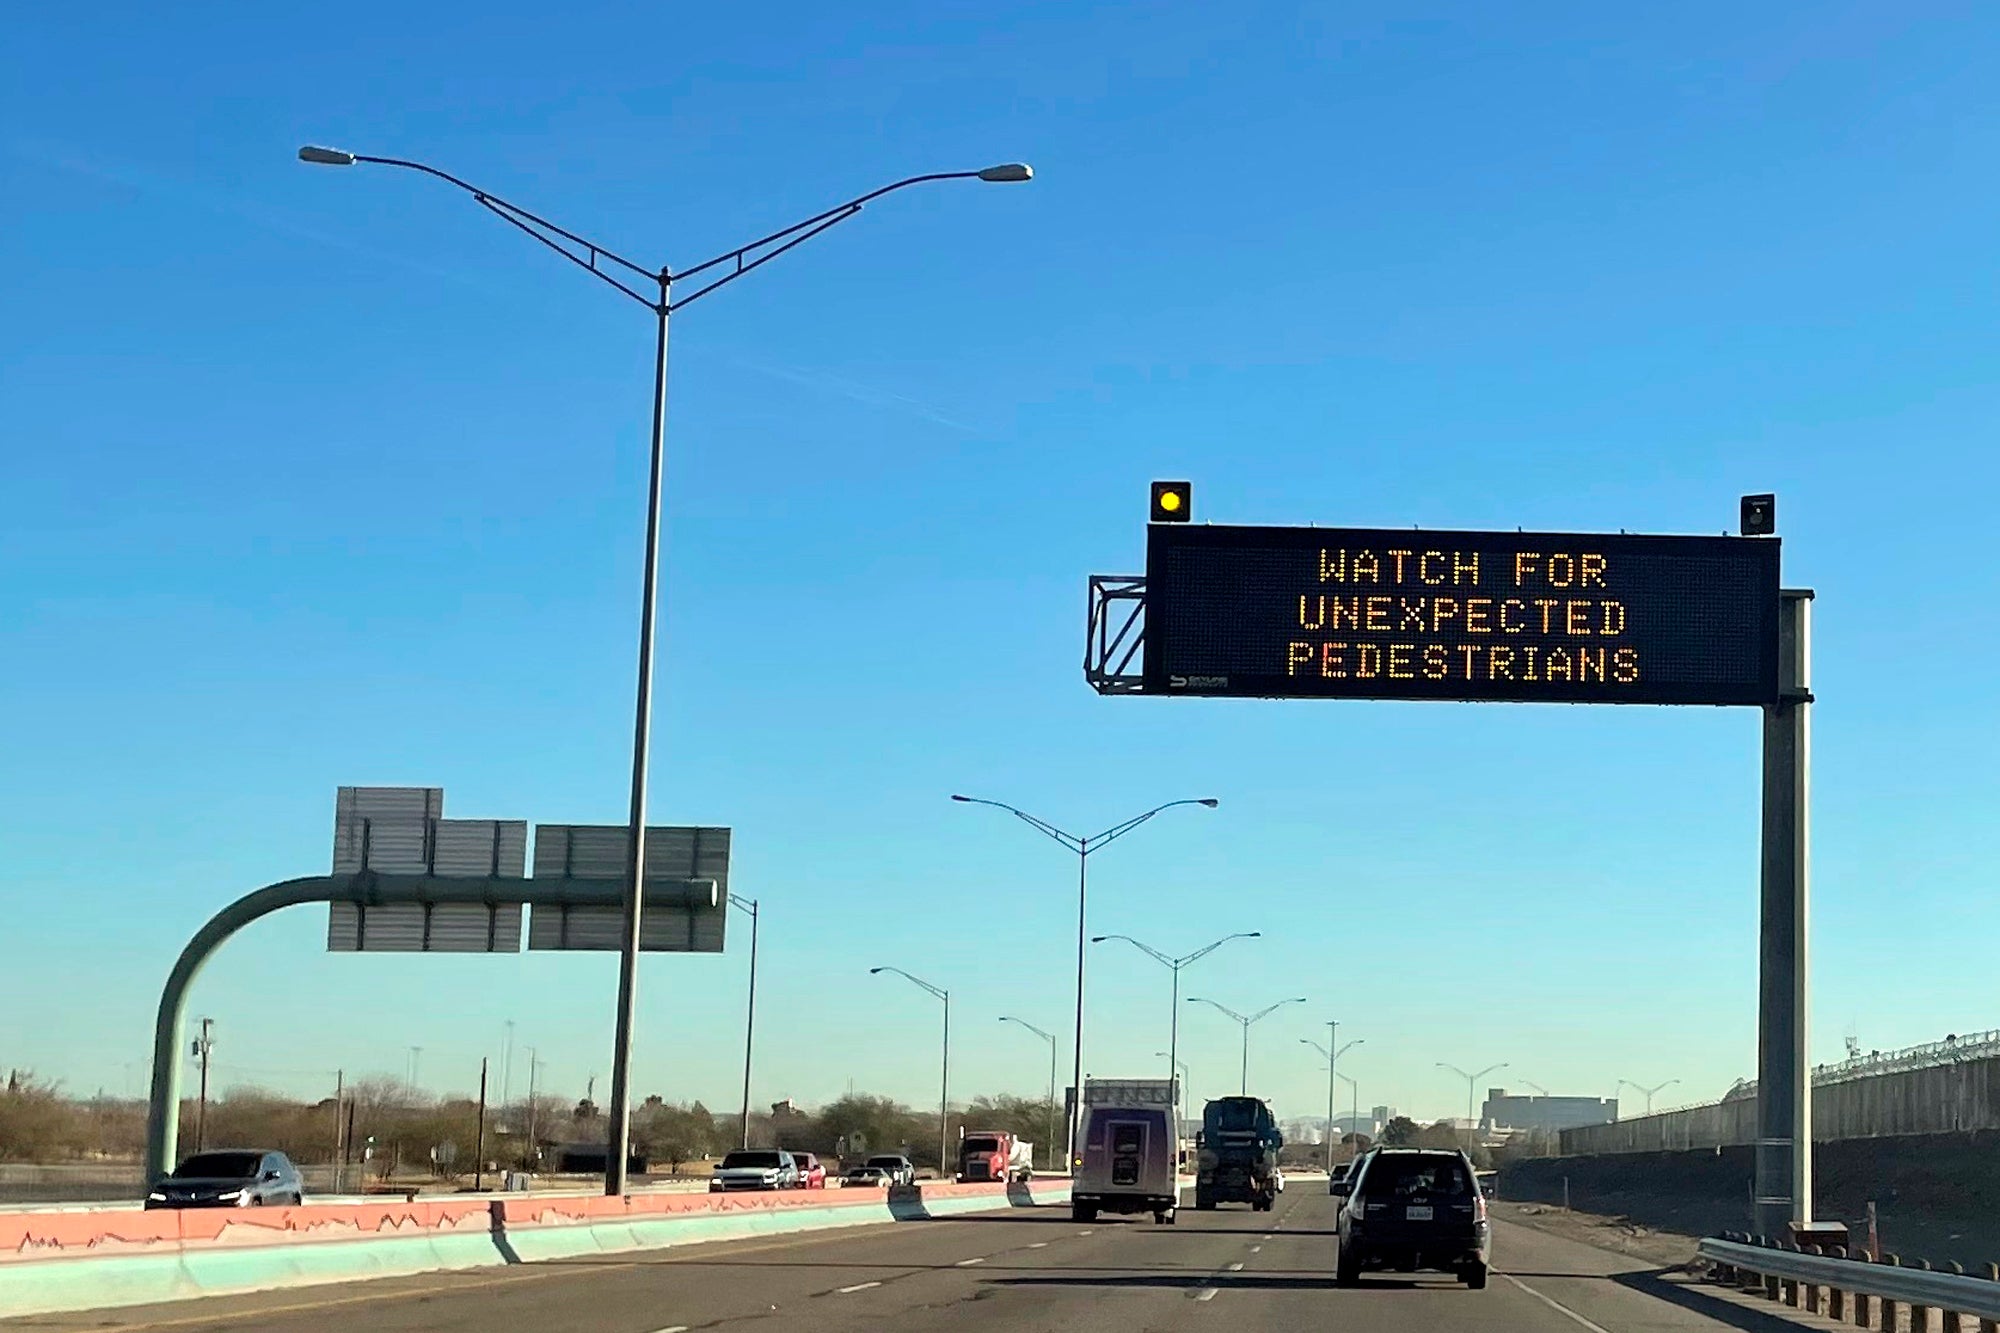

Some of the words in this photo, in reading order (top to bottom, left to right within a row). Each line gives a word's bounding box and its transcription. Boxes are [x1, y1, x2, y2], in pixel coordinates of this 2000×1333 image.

[1319, 549, 1480, 587] WATCH
[1515, 553, 1607, 589] FOR
[1299, 595, 1626, 635] UNEXPECTED
[1288, 642, 1640, 684] PEDESTRIANS
